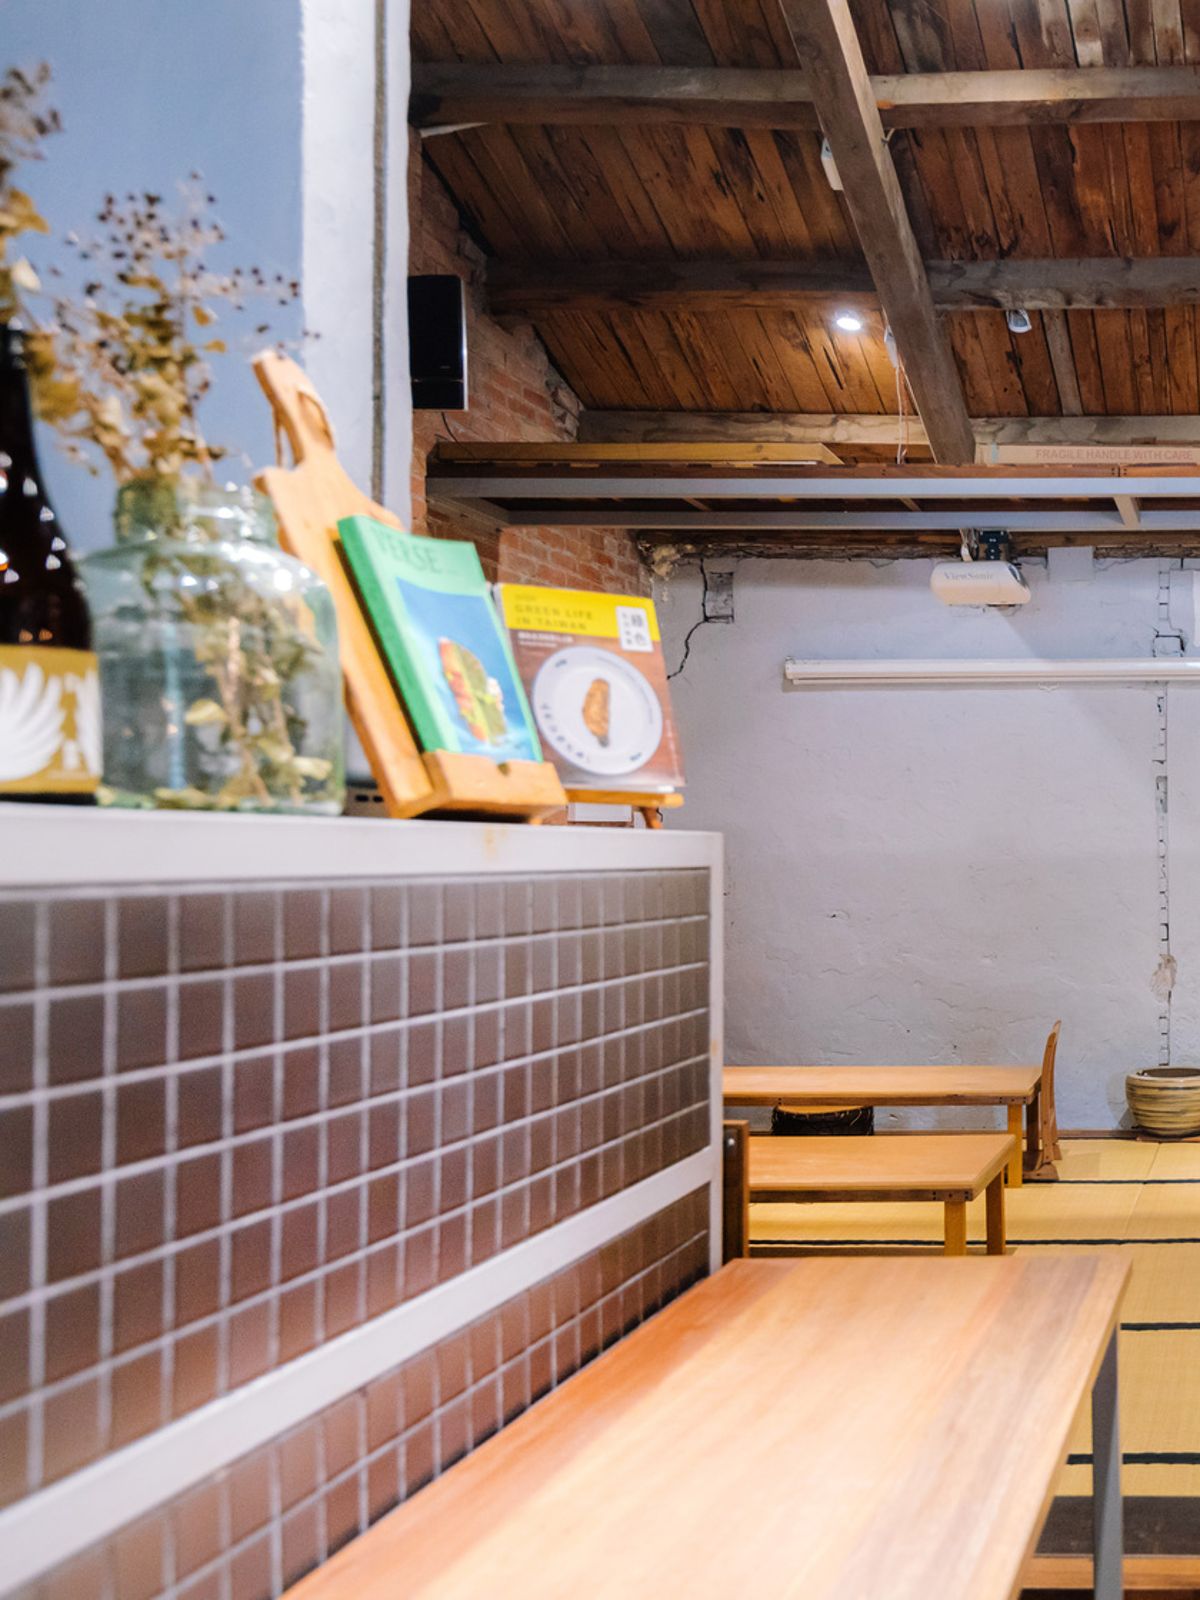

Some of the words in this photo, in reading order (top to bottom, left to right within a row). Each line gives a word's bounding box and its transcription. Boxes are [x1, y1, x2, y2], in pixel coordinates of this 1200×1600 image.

[1036, 450, 1082, 460] FRAGILE
[1086, 450, 1128, 460] HANDLE
[1133, 450, 1162, 460] WITH
[1164, 450, 1193, 461] CARE
[514, 604, 560, 617] GREEN
[565, 609, 592, 621] LIFE
[516, 616, 530, 625] IN
[538, 617, 587, 631] TAIWAN
